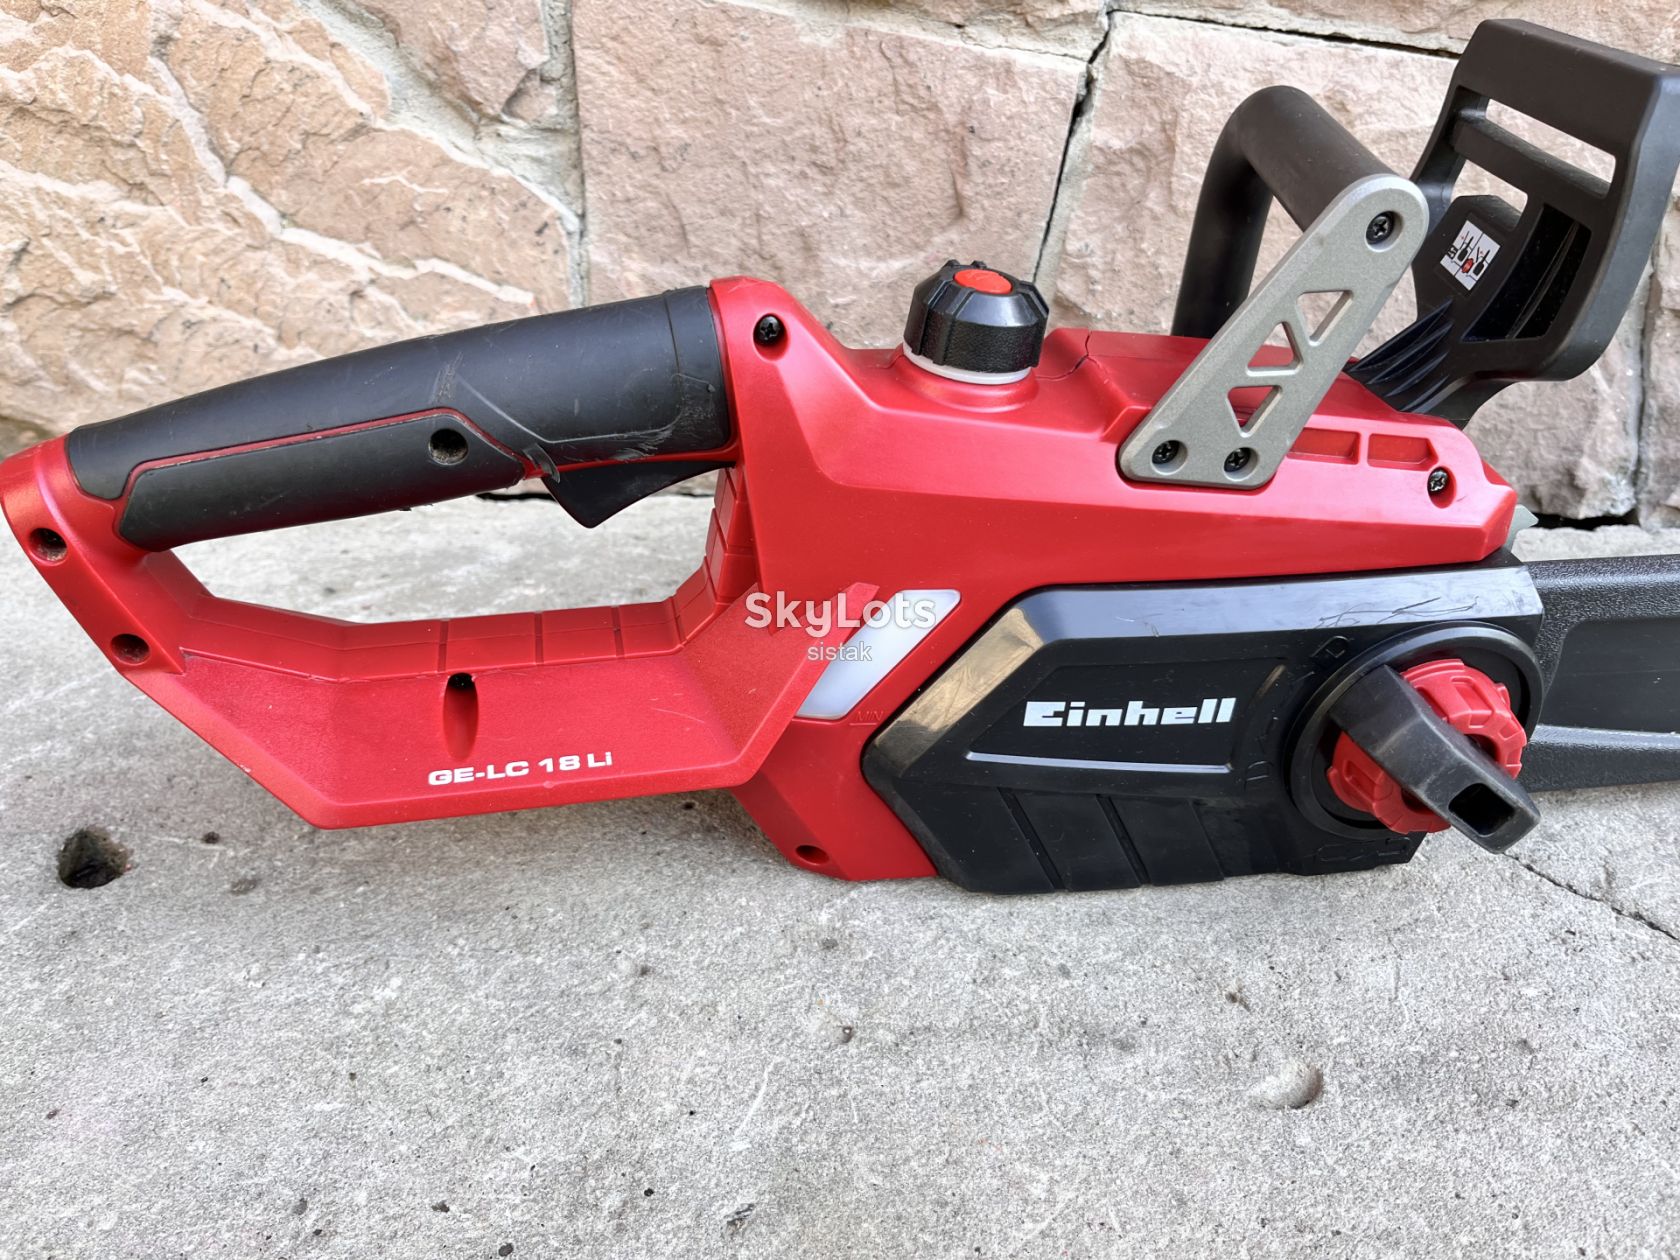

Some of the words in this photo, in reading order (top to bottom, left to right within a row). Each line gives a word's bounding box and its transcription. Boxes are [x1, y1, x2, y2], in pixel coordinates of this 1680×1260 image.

[1023, 697, 1237, 727] Einhell
[428, 761, 530, 786] GE-LC
[538, 755, 581, 773] 18
[587, 751, 613, 768] Li
